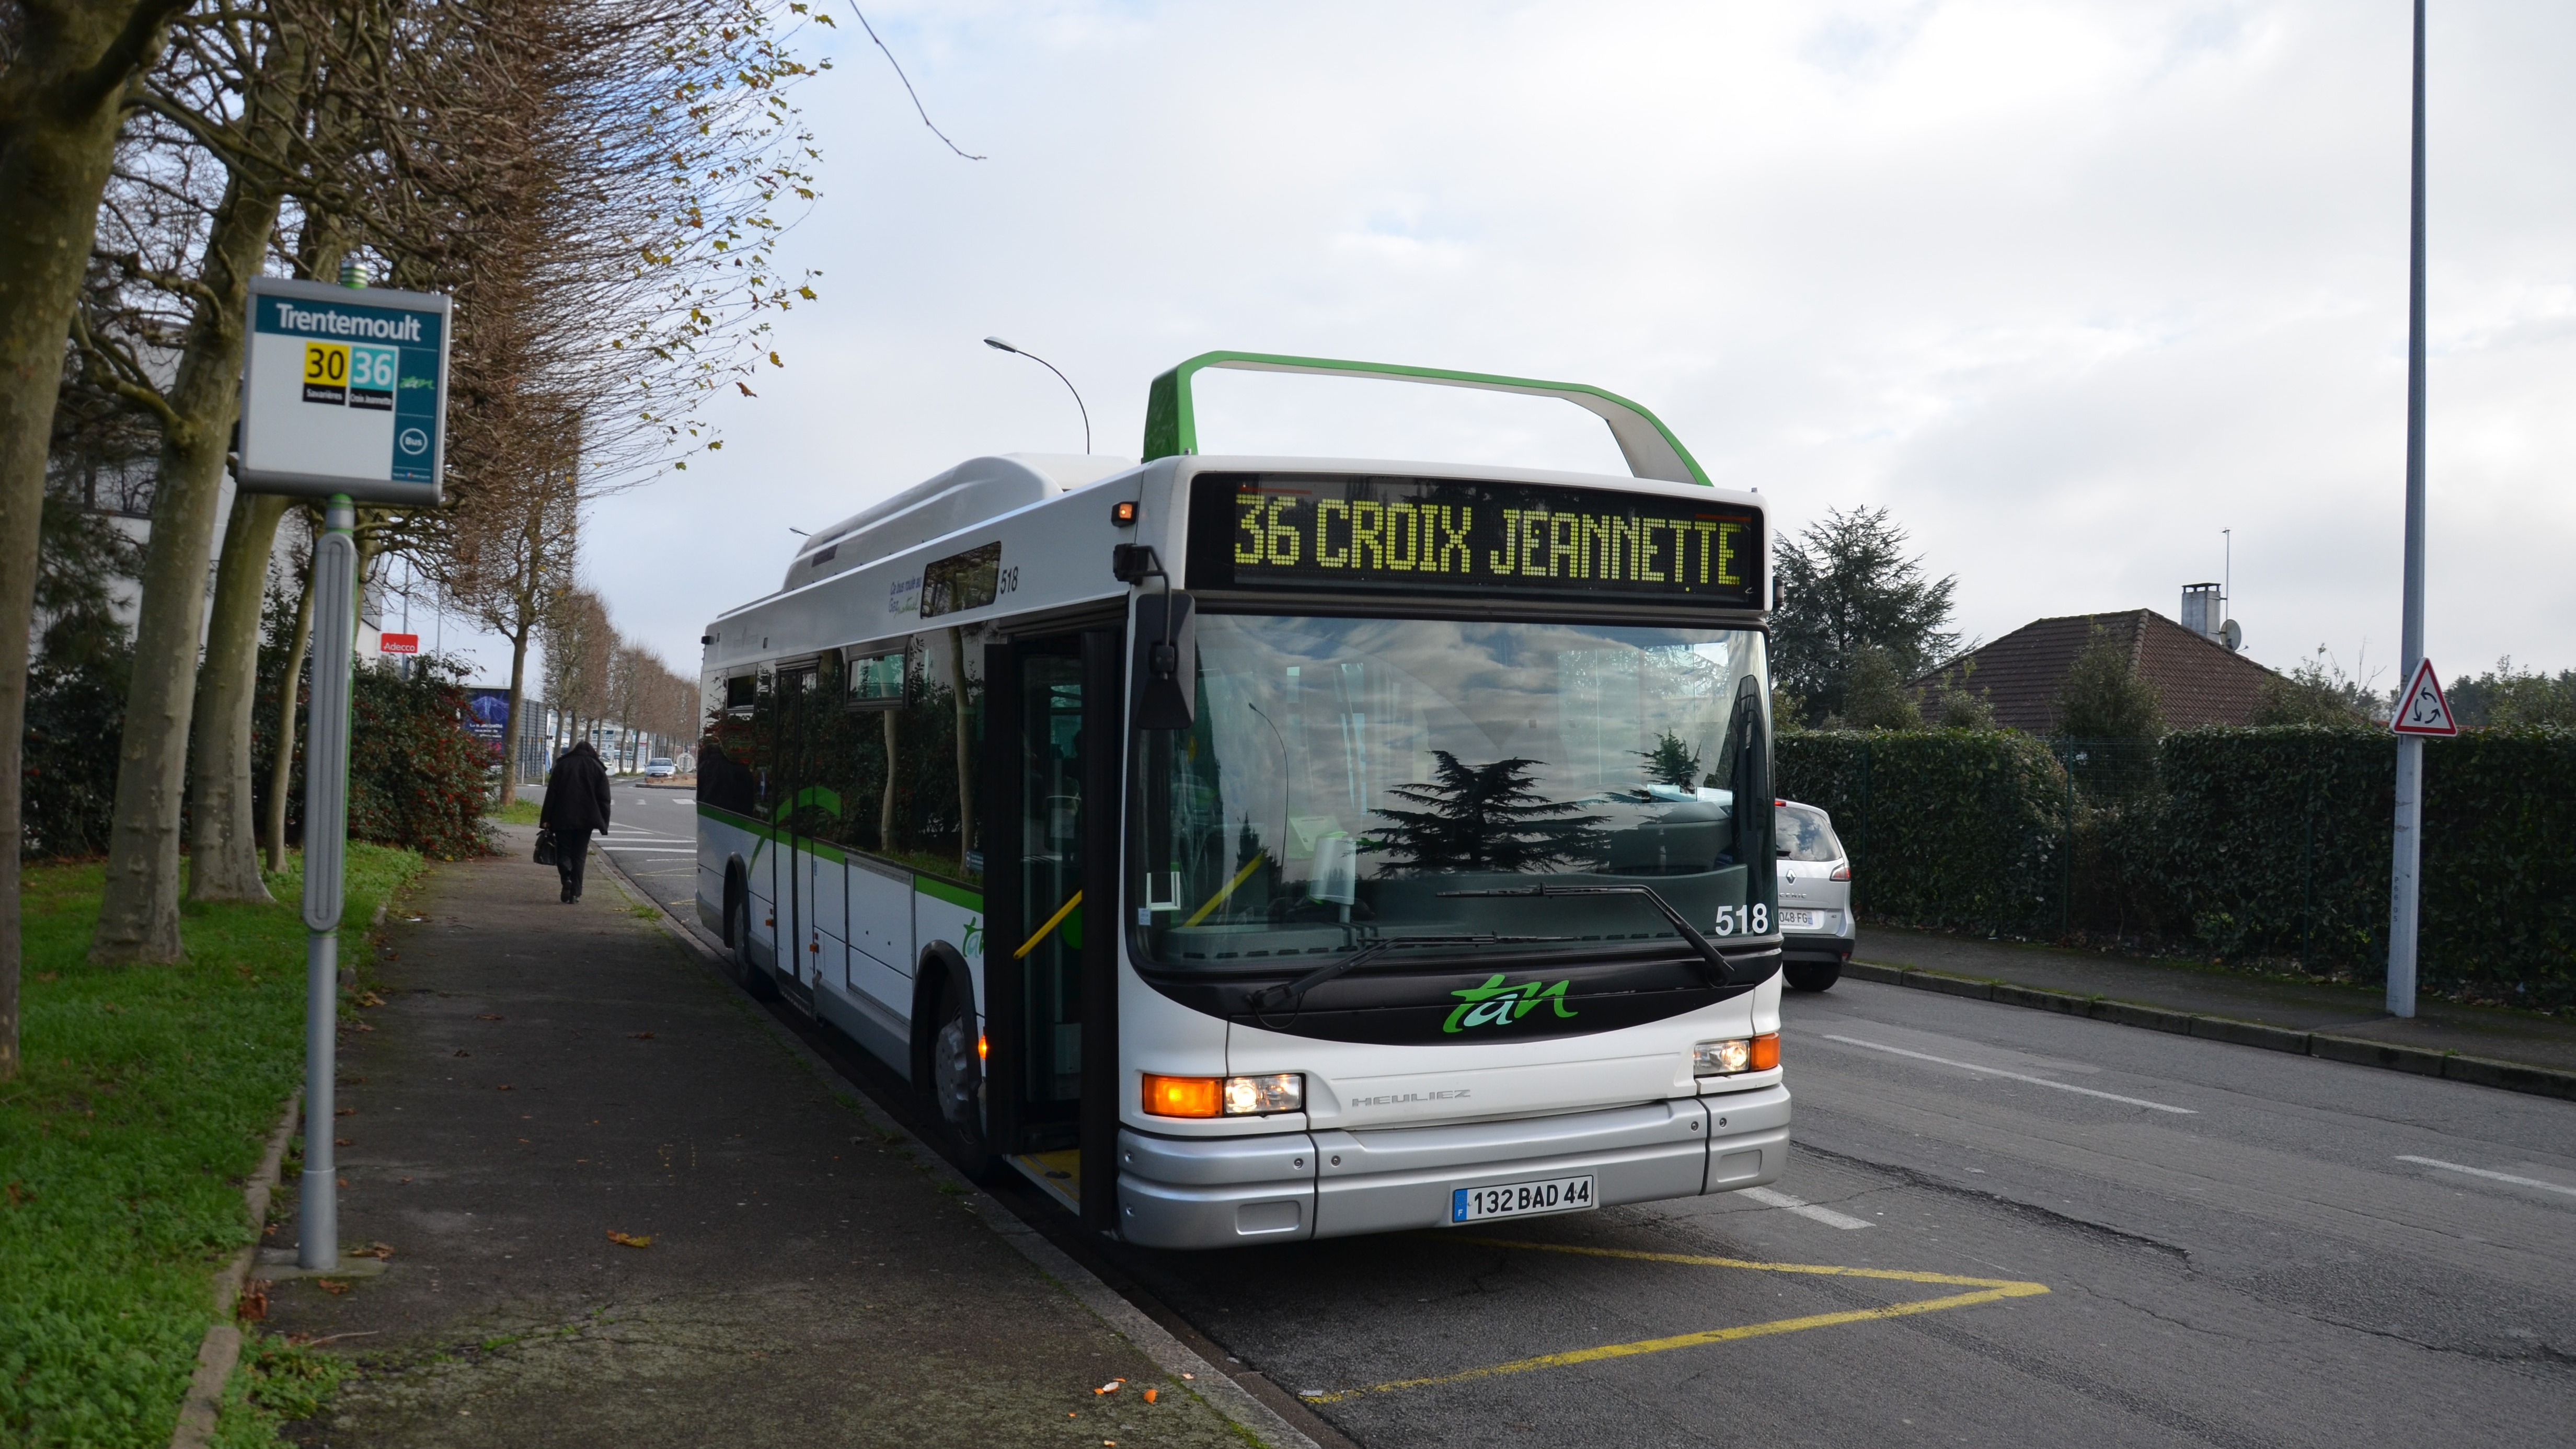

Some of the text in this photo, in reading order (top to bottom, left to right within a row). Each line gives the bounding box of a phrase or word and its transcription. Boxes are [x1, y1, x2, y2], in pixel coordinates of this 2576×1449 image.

[275, 303, 421, 342] Trentemoult
[307, 348, 344, 380] 30
[353, 351, 392, 386] 36
[405, 436, 423, 447] Bus
[1235, 493, 1742, 585] 36 CROIX JEANNETTE
[1000, 566, 1019, 595] 518
[383, 642, 416, 651] Adecco
[1715, 903, 1768, 936] 518
[1443, 974, 1578, 1033] tan
[1352, 1089, 1471, 1108] HEULIEZ
[1474, 1180, 1589, 1214] 132 BAD 44
